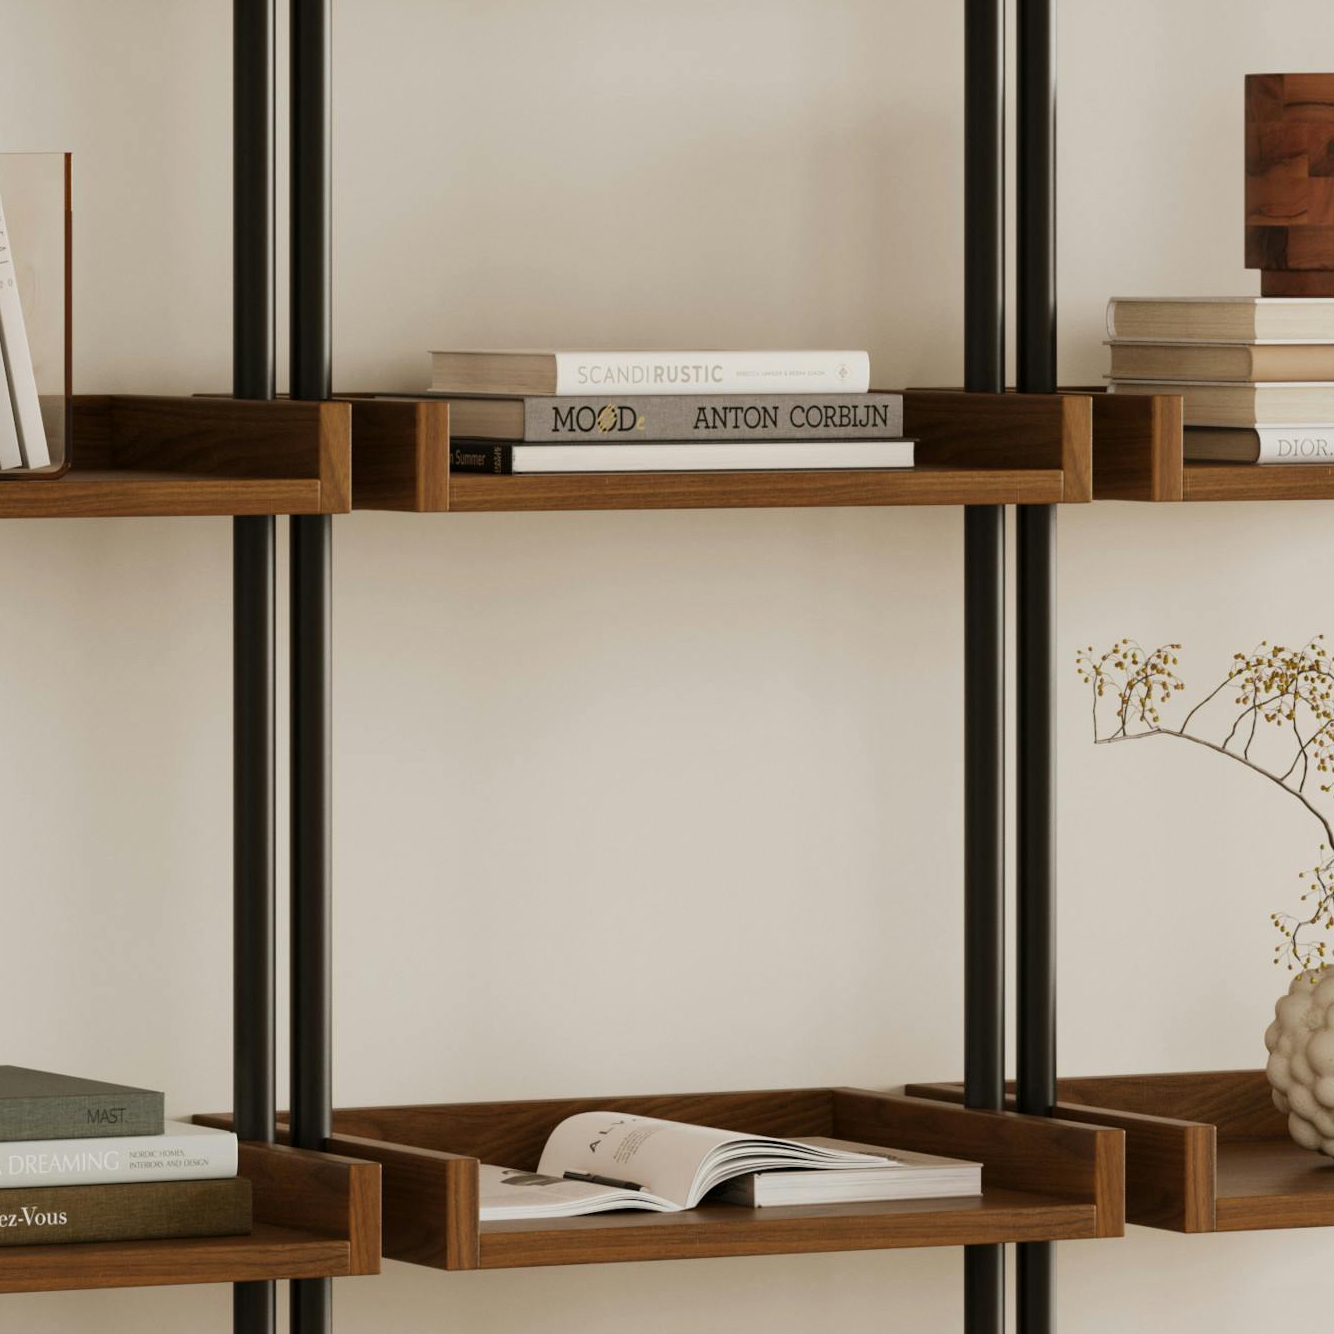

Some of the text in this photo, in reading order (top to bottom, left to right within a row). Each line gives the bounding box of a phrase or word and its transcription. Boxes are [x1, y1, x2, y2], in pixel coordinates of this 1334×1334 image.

[693, 404, 889, 430] ANTON CORBIJN
[1277, 438, 1334, 457] DIOR.
[8, 1150, 120, 1176] DREAMING
